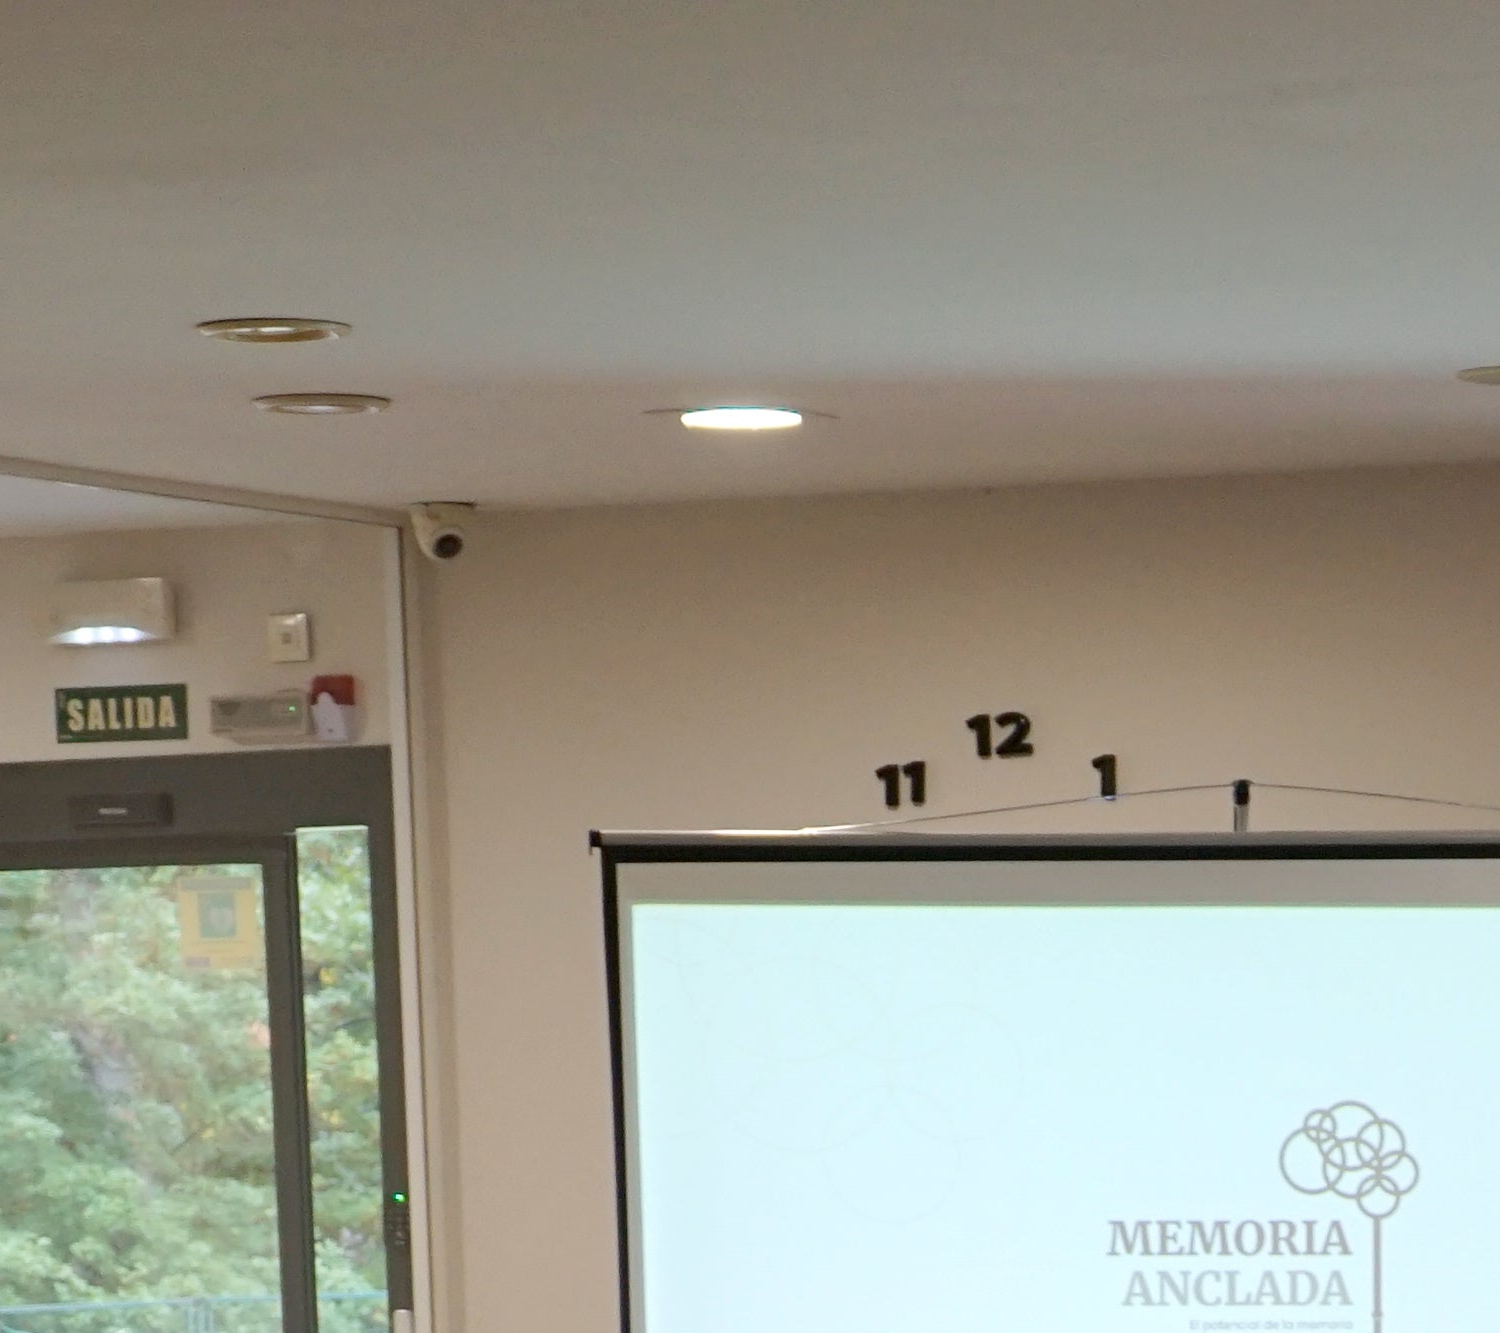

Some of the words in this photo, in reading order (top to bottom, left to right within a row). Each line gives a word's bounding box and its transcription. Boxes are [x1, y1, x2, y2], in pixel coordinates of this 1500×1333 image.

[66, 695, 176, 732] SALIDA
[966, 711, 1034, 759] 12
[874, 760, 927, 807] 11
[1091, 753, 1118, 798] 1
[1106, 1219, 1354, 1257] MEMORIA
[1121, 1269, 1354, 1307] ANCLADA
